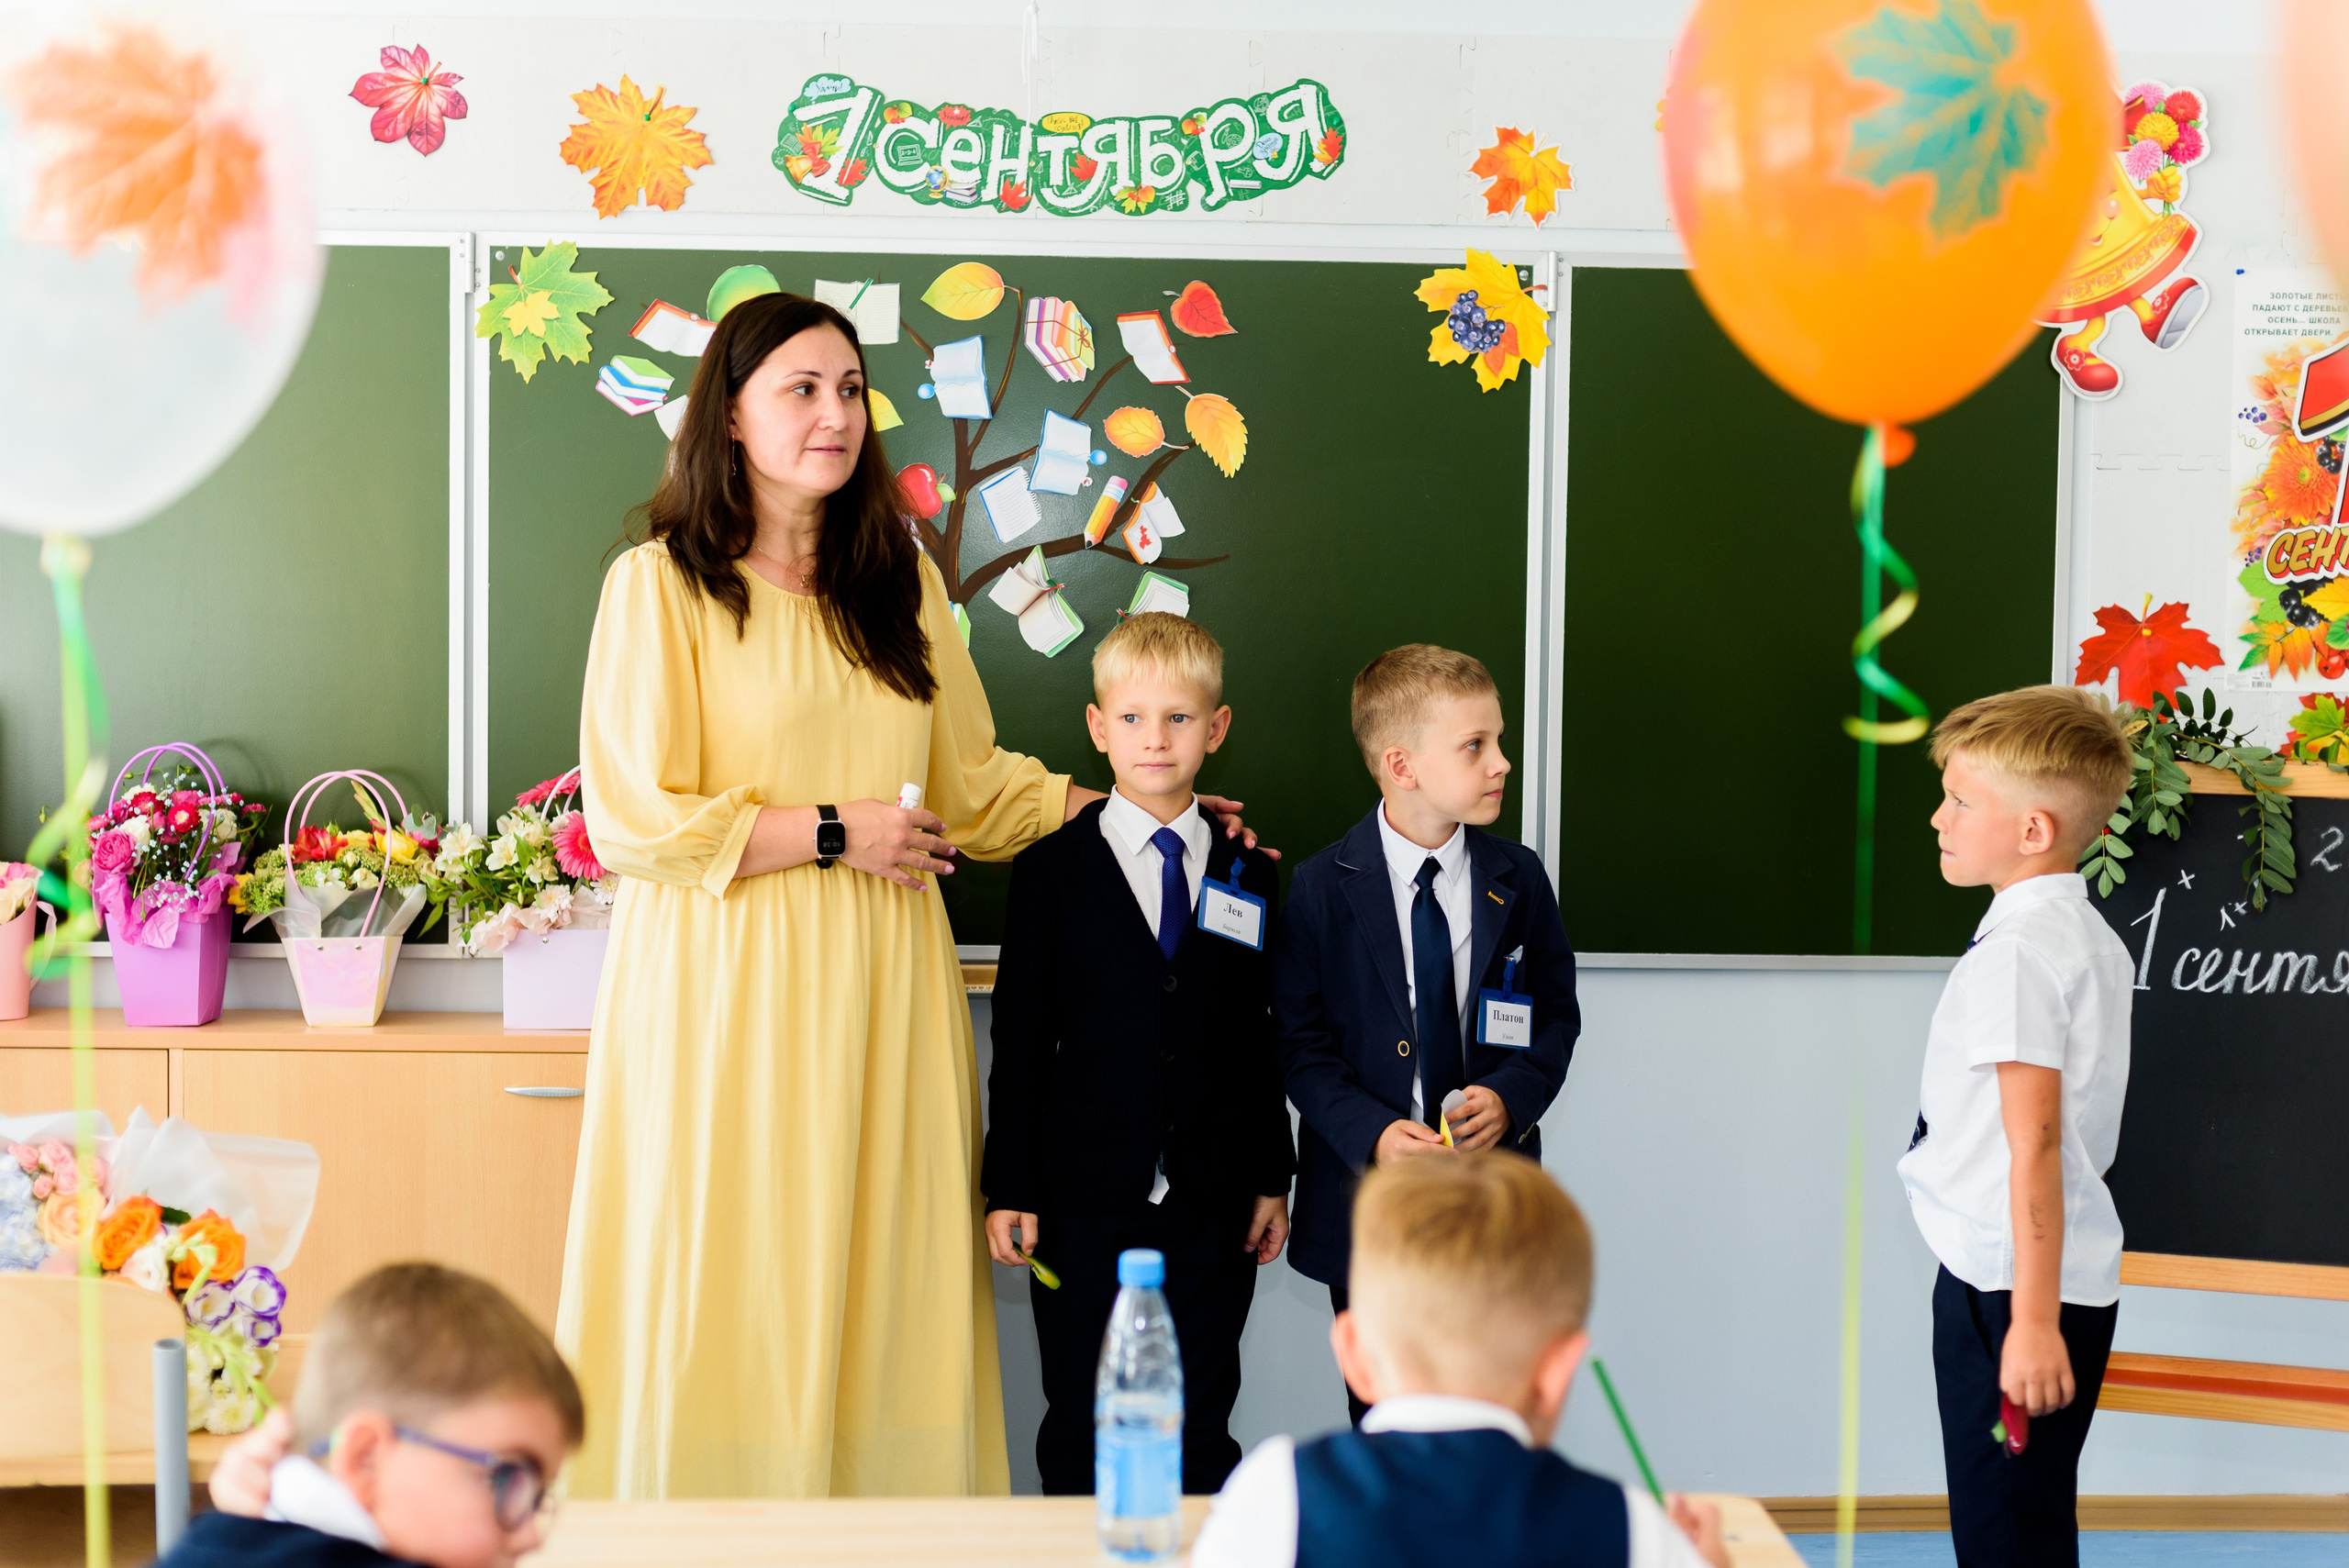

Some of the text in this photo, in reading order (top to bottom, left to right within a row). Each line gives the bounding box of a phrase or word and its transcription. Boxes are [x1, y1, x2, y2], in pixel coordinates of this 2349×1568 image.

[2270, 292, 2313, 300] ЗОЛОТЫЕ
[2253, 304, 2292, 313] ПАДАЮТ
[2309, 317, 2341, 325] ШКОЛА
[2301, 329, 2333, 338] ДВЕРИ.
[1223, 903, 1242, 917] Лев
[2130, 887, 2166, 991] 1
[1493, 1009, 1524, 1024] Платон
